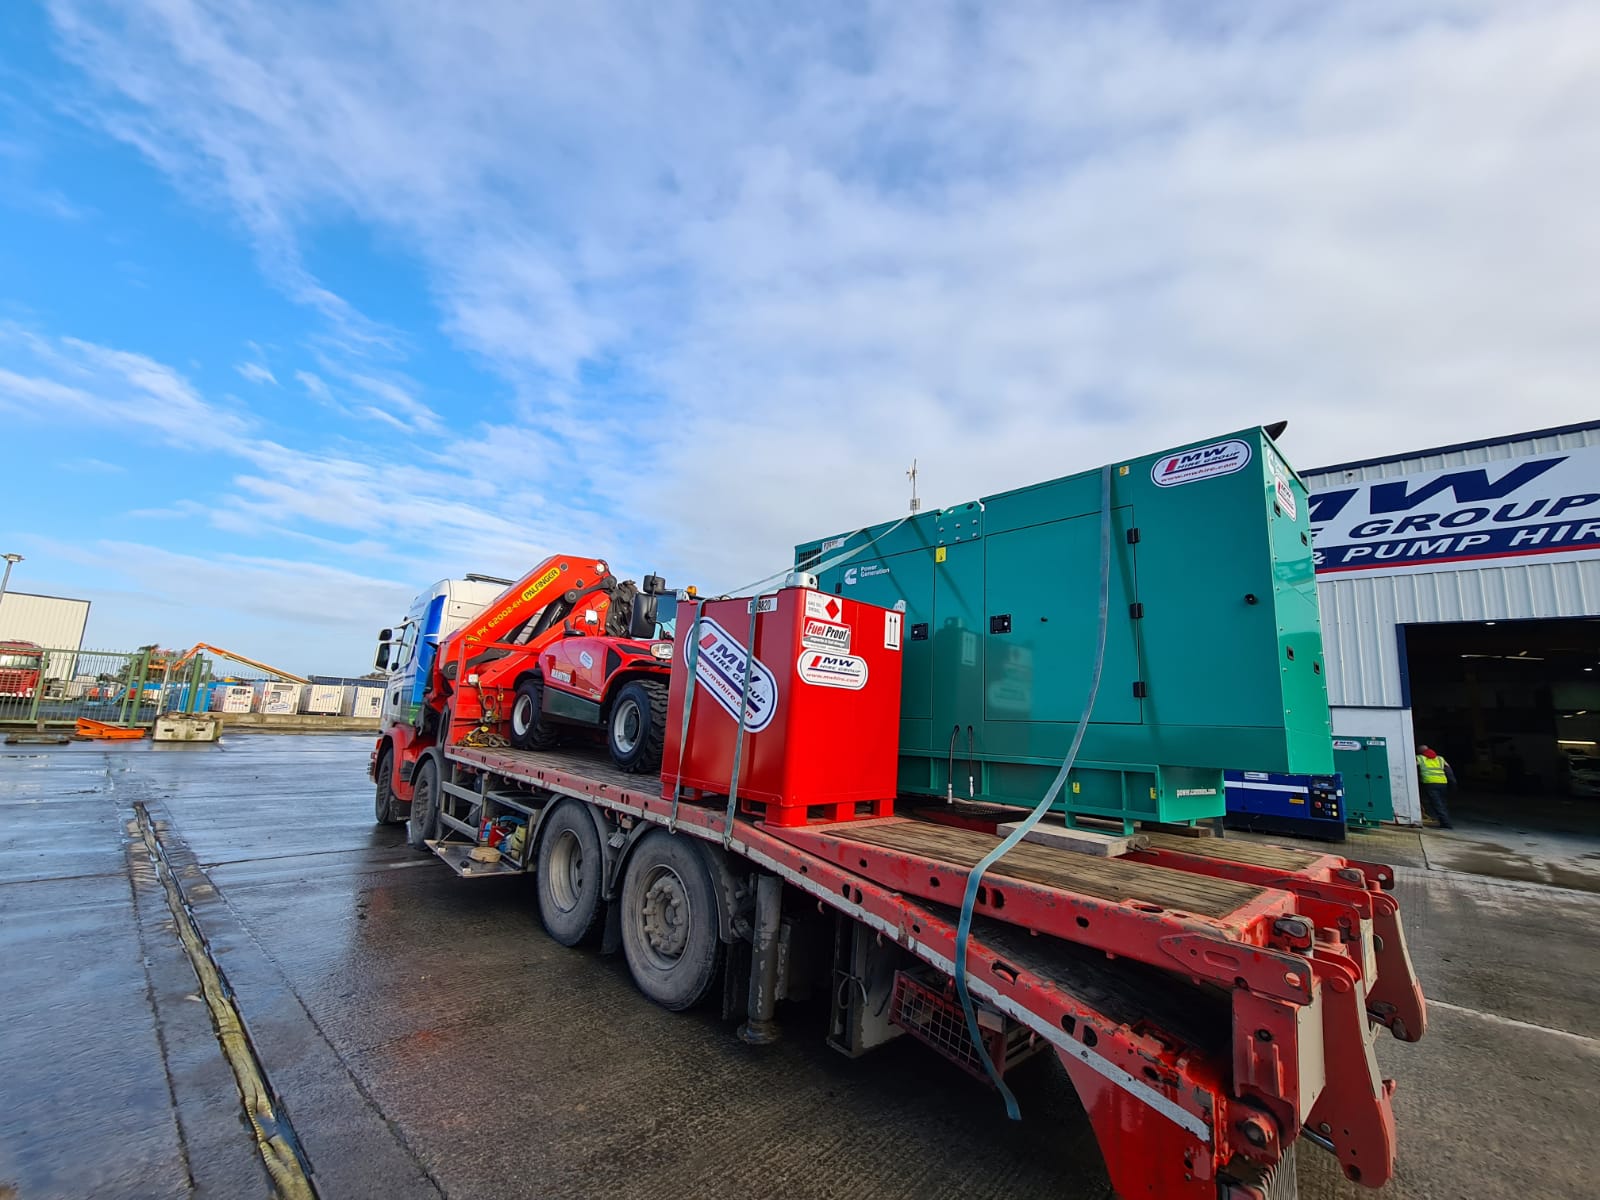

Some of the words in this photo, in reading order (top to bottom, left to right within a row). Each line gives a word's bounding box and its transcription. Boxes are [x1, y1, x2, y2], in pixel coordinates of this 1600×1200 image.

[1349, 493, 1600, 539] GROUP
[1341, 534, 1491, 563] PUMP
[523, 568, 559, 600] PALFINGER
[807, 622, 826, 637] Fuel
[825, 625, 848, 641] Proof
[709, 650, 733, 672] HIRE
[697, 661, 754, 719] ww.mwhire.cm
